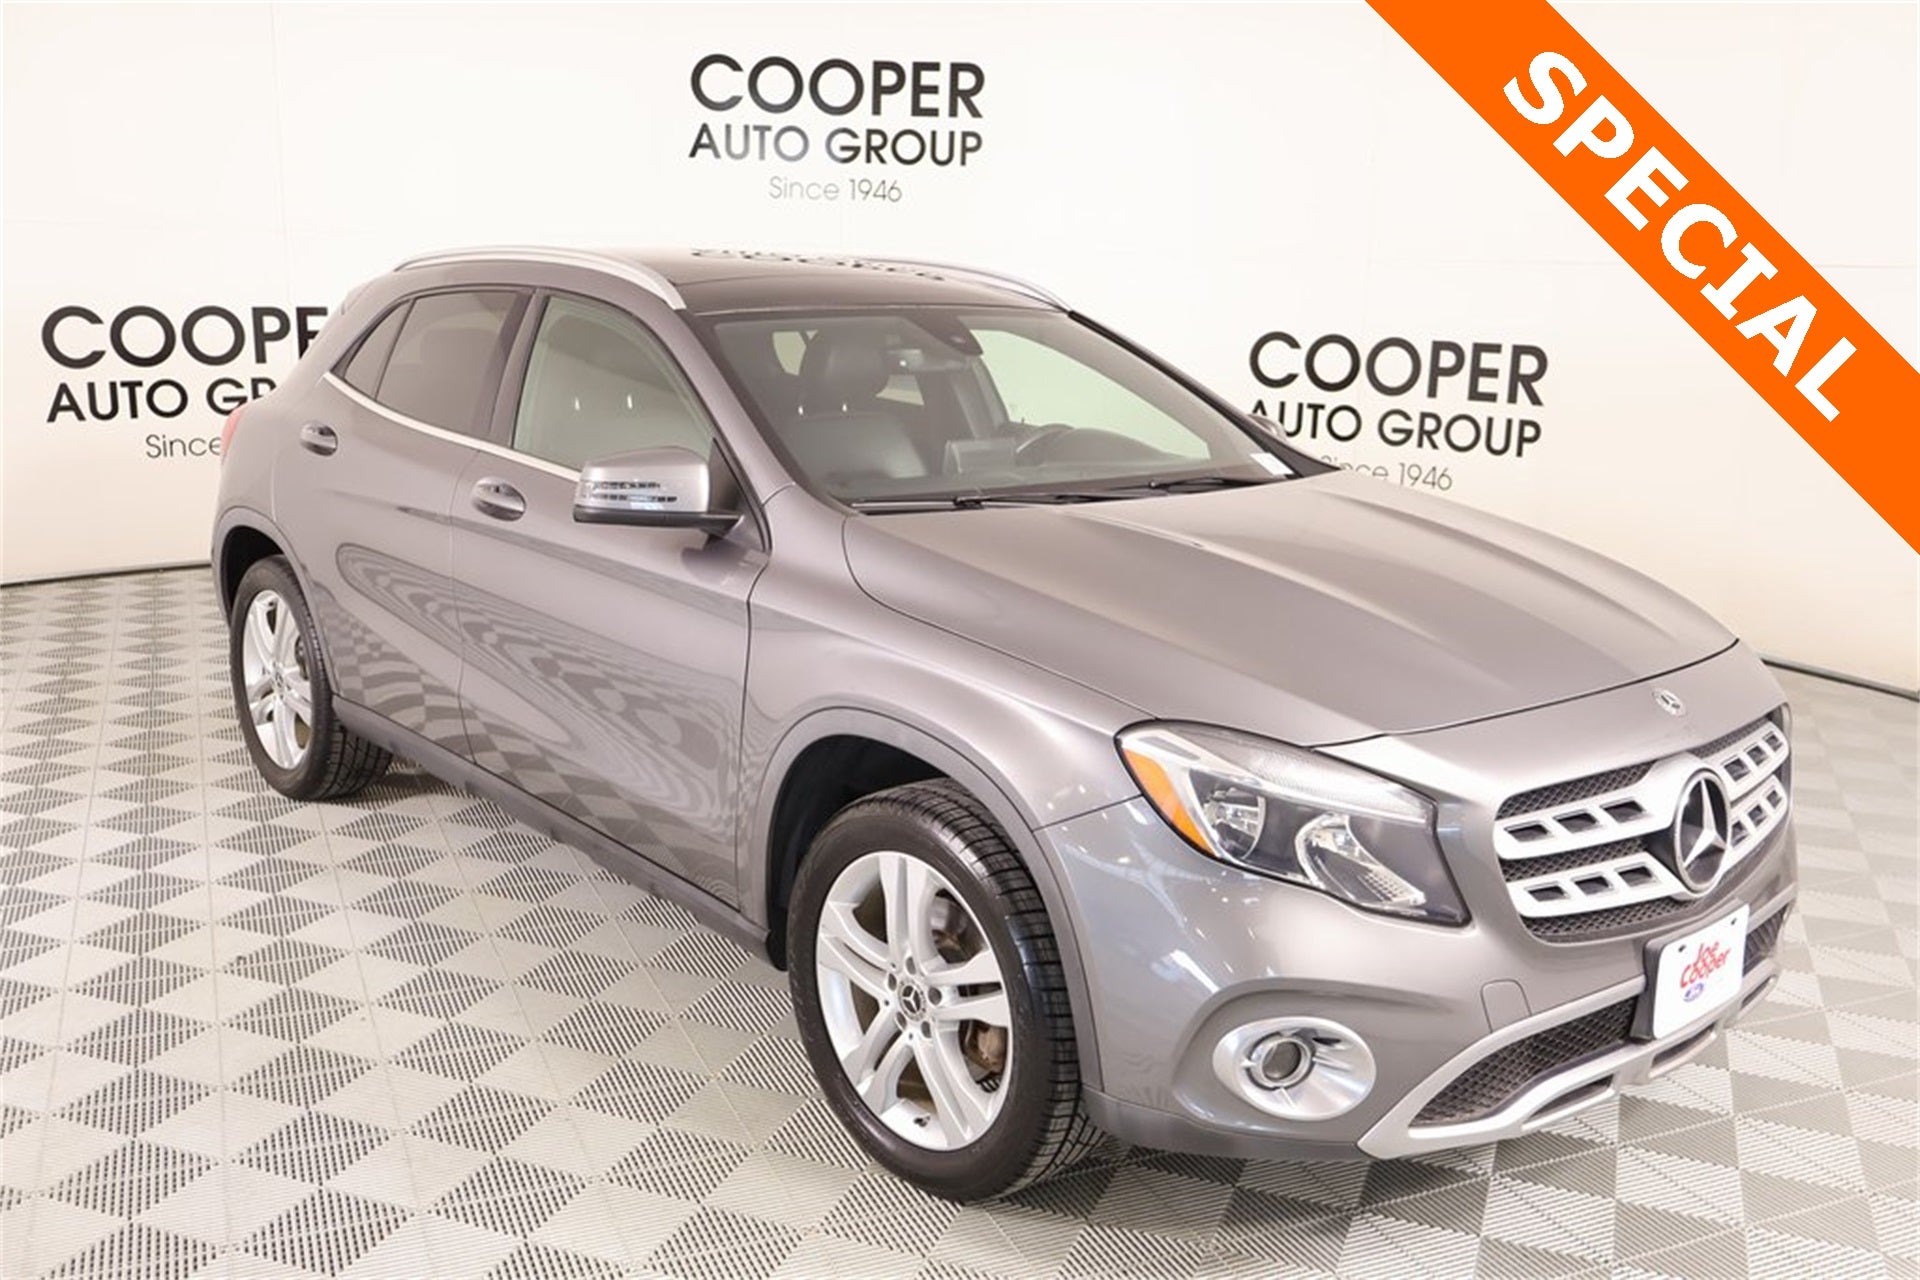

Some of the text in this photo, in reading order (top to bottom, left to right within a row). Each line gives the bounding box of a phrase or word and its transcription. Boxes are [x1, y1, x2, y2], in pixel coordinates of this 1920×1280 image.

[690, 53, 986, 119] COOPER
[688, 122, 983, 167] AUTO GROUP
[769, 175, 902, 203] Since 1946
[41, 305, 328, 369] COOPE
[1249, 331, 1548, 407] COOPER
[46, 378, 188, 423] AUTO
[145, 433, 221, 459] Since
[1377, 408, 1542, 458] GROUP
[1399, 462, 1453, 492] 1946
